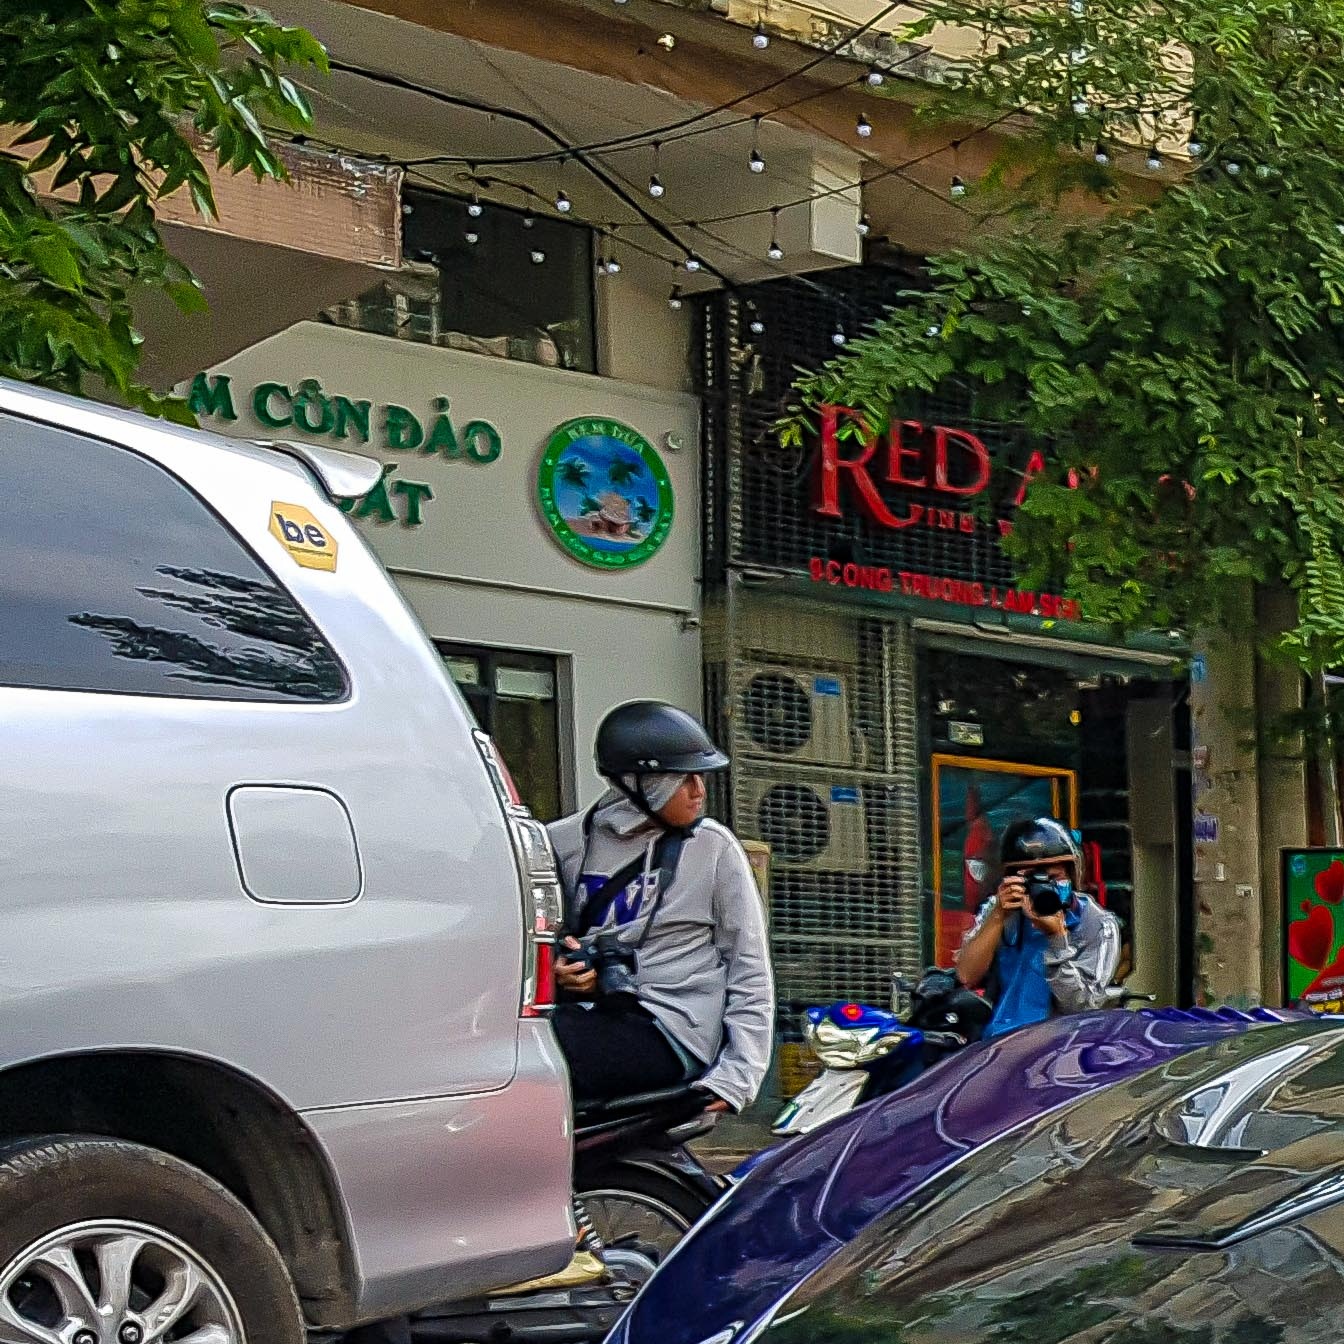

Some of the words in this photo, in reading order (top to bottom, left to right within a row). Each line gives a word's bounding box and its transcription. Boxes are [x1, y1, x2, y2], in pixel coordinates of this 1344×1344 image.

[253, 378, 372, 443] CÔN
[384, 394, 502, 464] ĐẢO
[816, 403, 991, 529] RED
[274, 513, 328, 548] be
